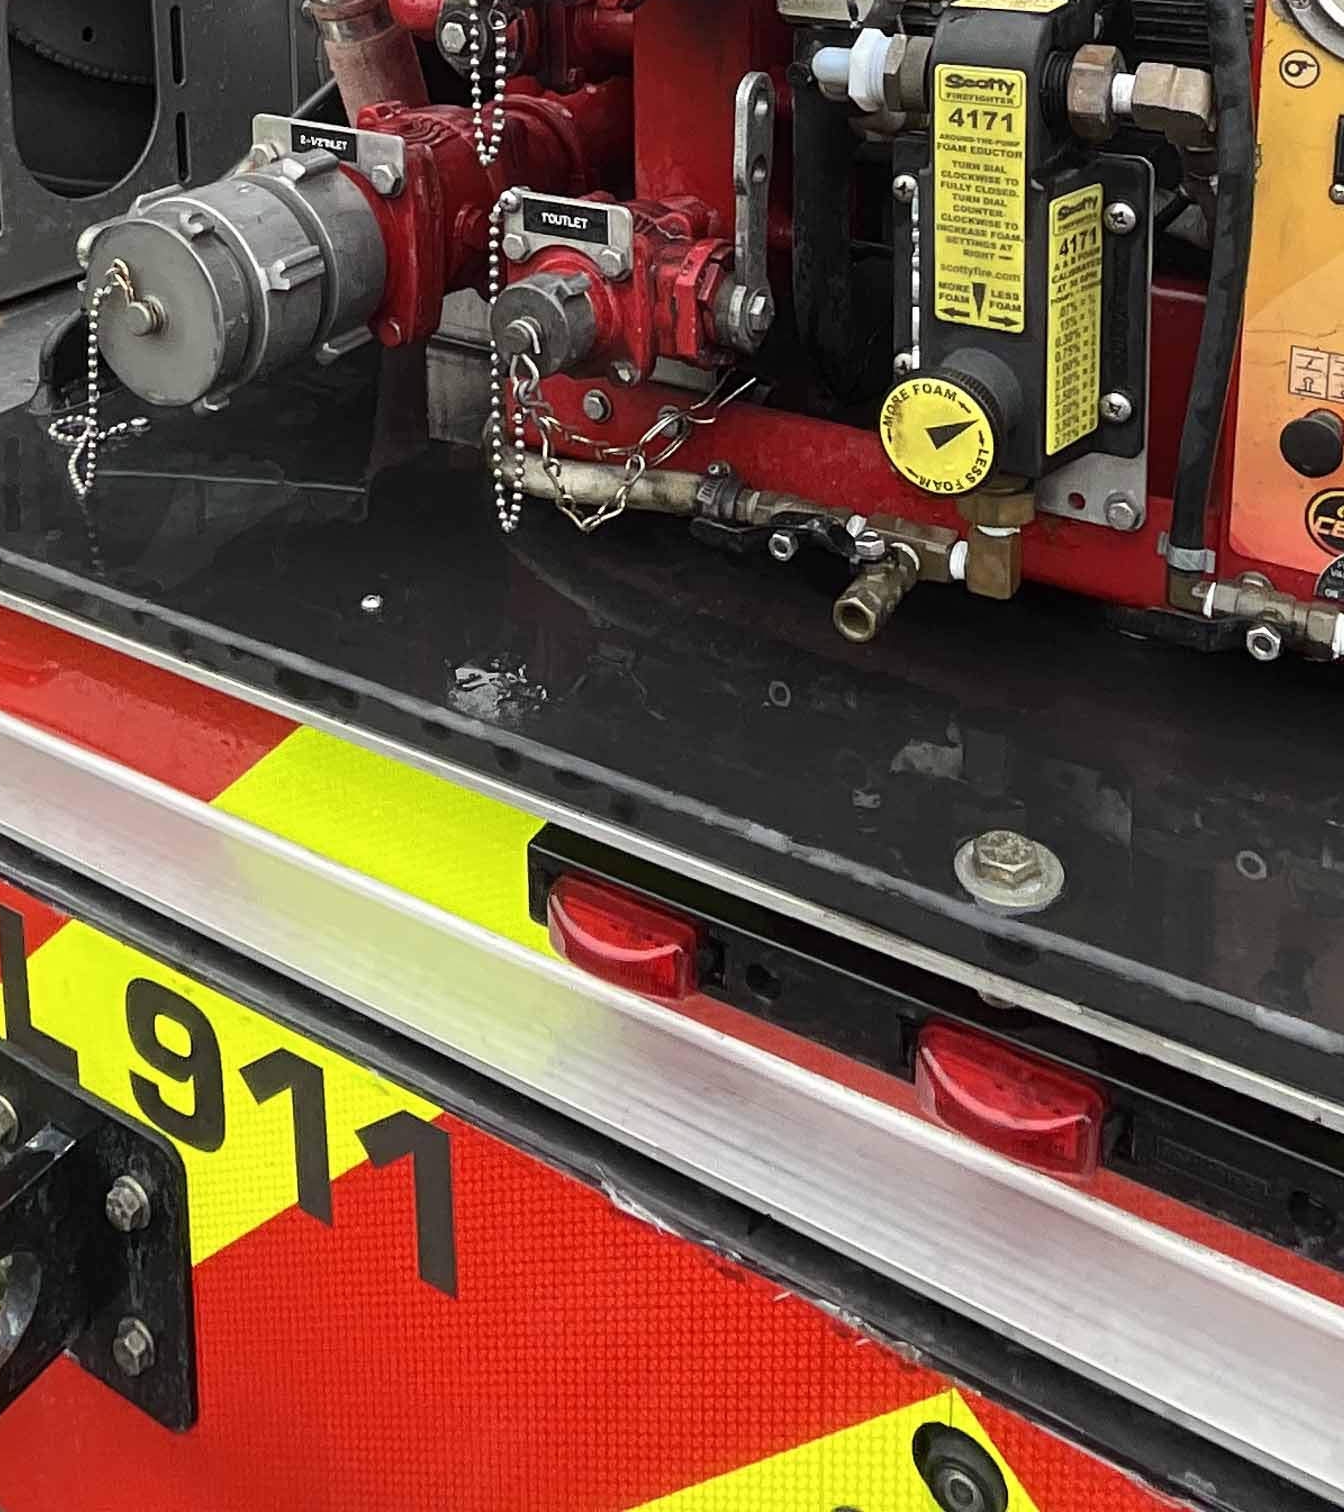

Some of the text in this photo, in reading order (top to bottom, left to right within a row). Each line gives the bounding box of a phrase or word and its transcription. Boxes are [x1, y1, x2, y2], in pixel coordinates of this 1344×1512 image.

[944, 73, 1016, 97] Scotty
[946, 92, 1014, 105] FIREFIGHTER
[948, 107, 1013, 133] 4171
[937, 142, 1023, 159] FOAM EDUCTOR
[1059, 226, 1097, 256] 4171
[939, 263, 1022, 282] scottyfire.com
[938, 281, 971, 293] MORE
[991, 289, 1020, 301] LESS
[938, 292, 971, 304] FOAM
[989, 300, 1023, 312] FOAM
[882, 383, 957, 427] MORE FOAM
[918, 448, 989, 492] LESS FOAM
[125, 977, 458, 1301] 911
